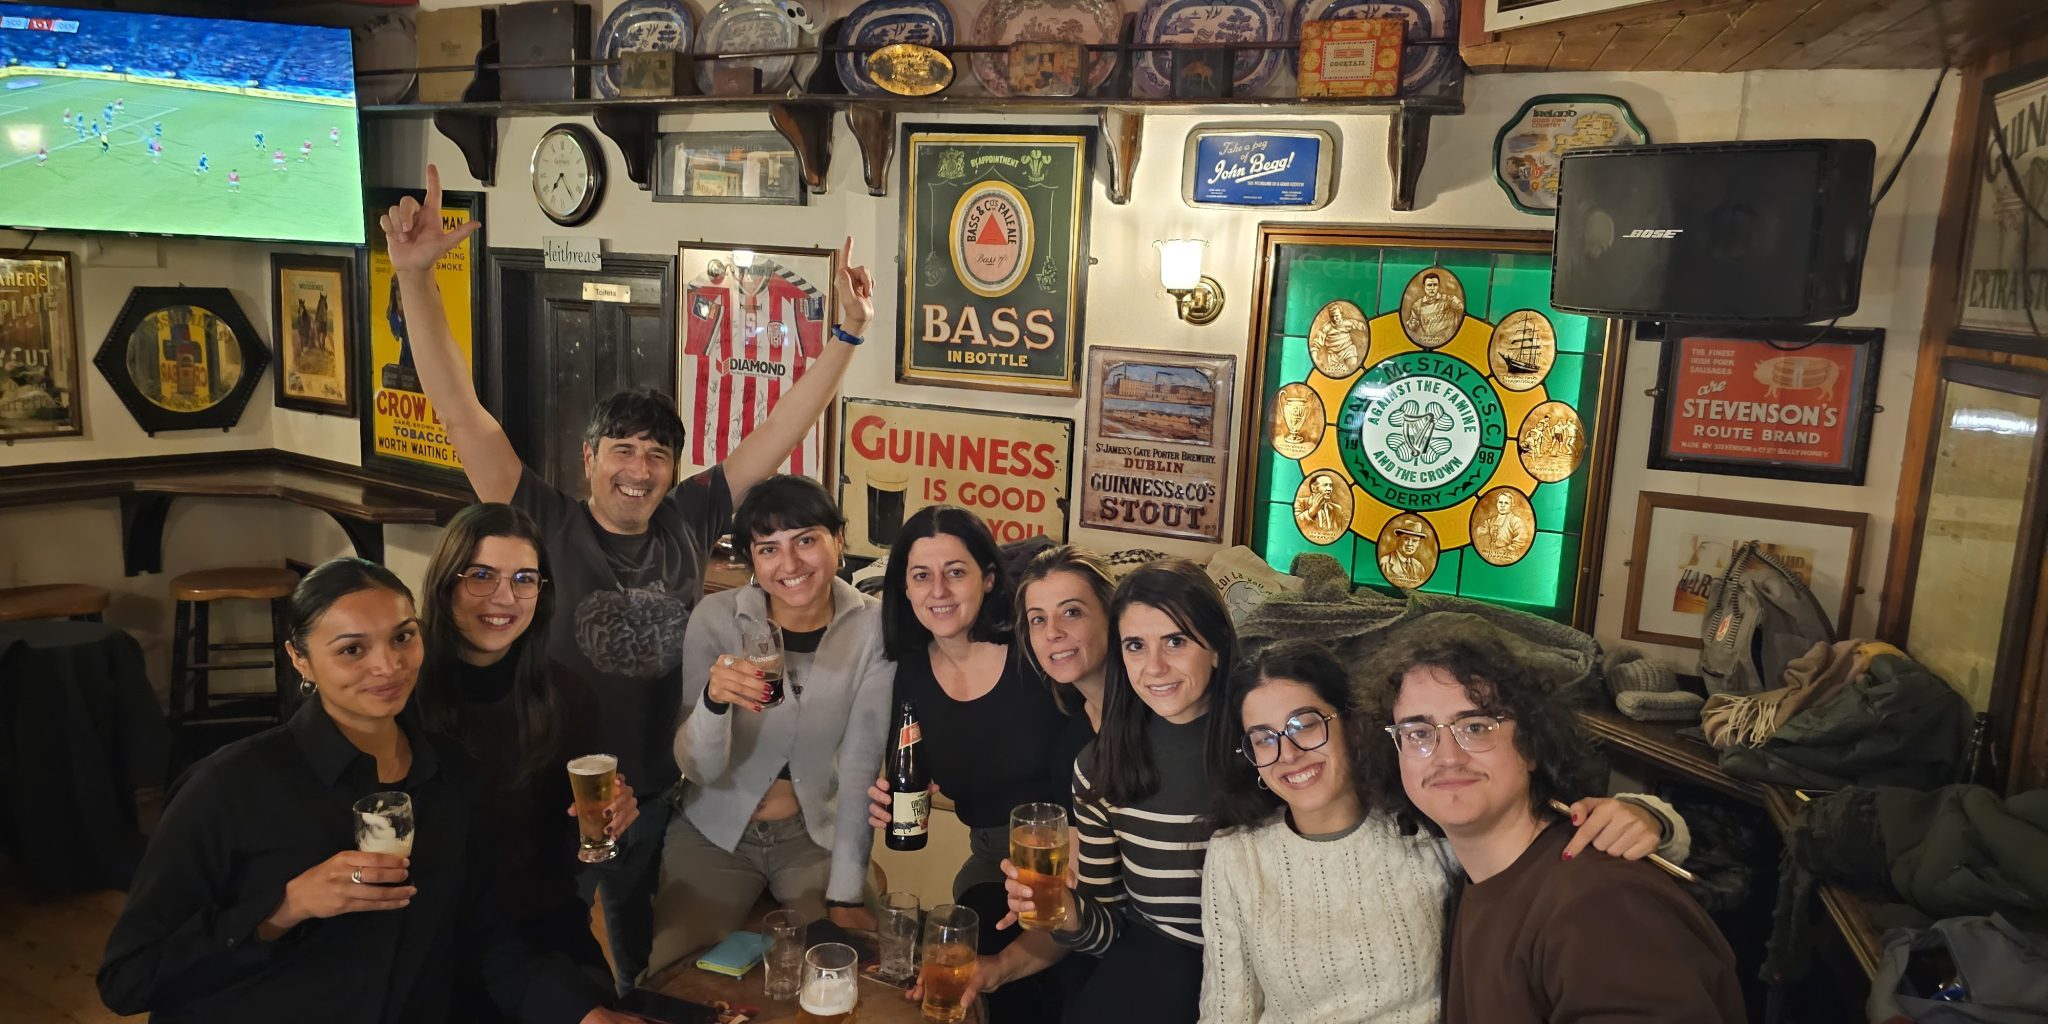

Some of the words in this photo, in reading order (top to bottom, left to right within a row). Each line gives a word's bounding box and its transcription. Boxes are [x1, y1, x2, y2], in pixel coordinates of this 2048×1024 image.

[1219, 140, 1243, 156] Take
[1252, 140, 1268, 152] peg
[979, 155, 1020, 168] APPOINTMENT
[1240, 152, 1249, 164] of
[1207, 159, 1246, 185] John
[1250, 151, 1296, 176] Begg!
[966, 214, 981, 242] BASS
[976, 205, 985, 216] &
[998, 202, 1016, 226] PALE
[1007, 228, 1017, 245] ALE
[1622, 229, 1684, 239] BOSE
[548, 240, 597, 265] leithreas
[436, 263, 463, 271] SMOKE
[596, 289, 617, 297] Toilets
[922, 303, 1056, 350] BASS
[947, 350, 962, 364] IN
[964, 351, 1029, 368] BOTTLE
[1708, 349, 1736, 357] FINEST
[729, 358, 786, 376] DIAMOND
[1689, 366, 1733, 375] SAUSAGES
[1697, 380, 1728, 396] are
[377, 391, 426, 422] CROW
[1367, 383, 1412, 426] AGAINST
[1416, 379, 1442, 395] THE
[1442, 387, 1477, 433] FAMINE
[1682, 398, 1838, 428] STEVENSON'S
[1693, 424, 1753, 440] ROUTE
[1762, 429, 1821, 445] BRAND
[378, 436, 407, 452] WORTH
[411, 442, 448, 460] WAITING
[851, 415, 1056, 480] GUINNESS
[1133, 446, 1151, 457] GATE
[1152, 449, 1180, 460] PORTER
[1681, 441, 1700, 449] MADE
[1124, 457, 1185, 474] DUBLIN
[1373, 450, 1396, 474] AND
[1394, 466, 1417, 483] THE
[1419, 456, 1464, 483] CROWN
[1478, 450, 1495, 465] 98
[923, 477, 947, 502] IS
[958, 481, 1046, 513] GOOD
[1384, 487, 1442, 507] DERRY
[1100, 496, 1206, 530] STOUT
[986, 518, 1044, 543] YOU
